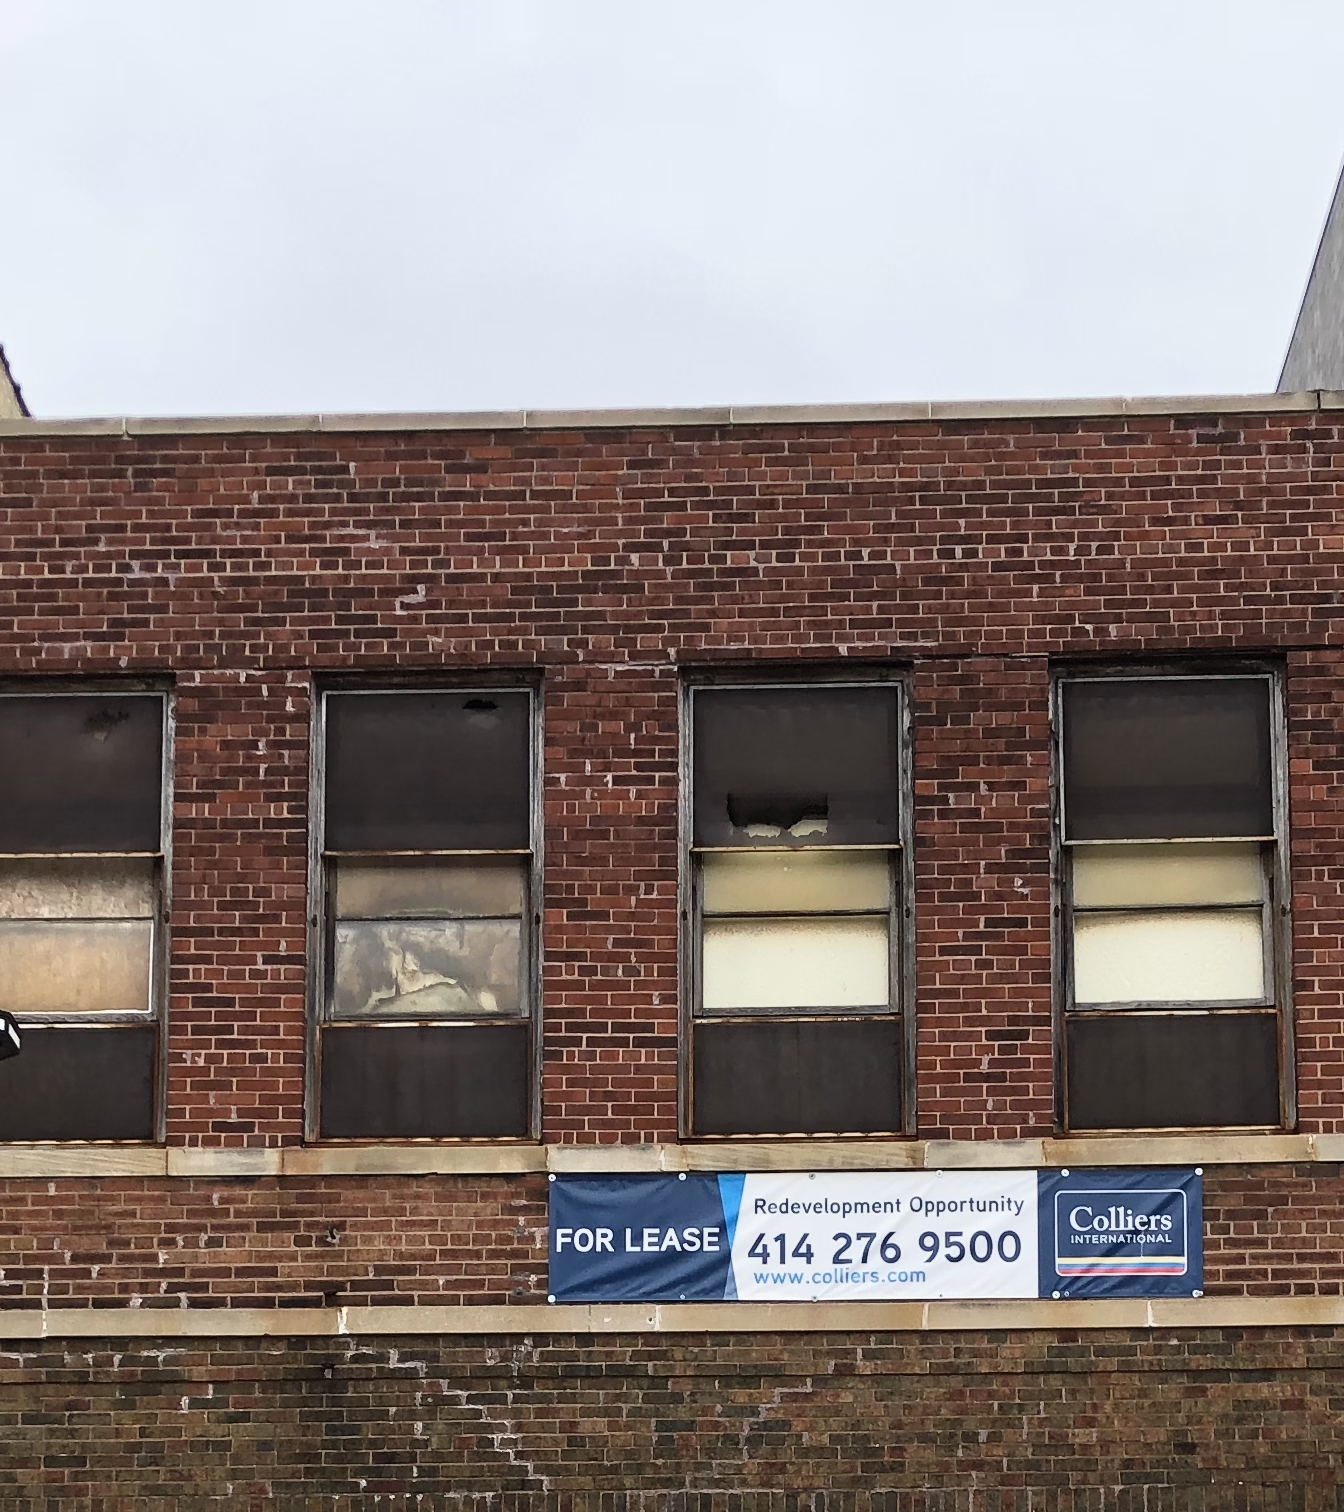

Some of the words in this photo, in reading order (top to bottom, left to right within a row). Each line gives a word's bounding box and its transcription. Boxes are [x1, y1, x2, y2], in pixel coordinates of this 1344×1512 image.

[754, 1197, 902, 1218] Redevelopment
[909, 1195, 1025, 1217] Opportunity
[1069, 1205, 1173, 1232] Colliers
[555, 1228, 615, 1253] FOR
[625, 1227, 721, 1252] LEASE
[747, 1232, 815, 1265] 414
[831, 1231, 902, 1264] 276
[918, 1230, 1022, 1263] 9500
[1070, 1233, 1173, 1244] INTERNATIONAL
[753, 1267, 926, 1284] www.colliers.com
